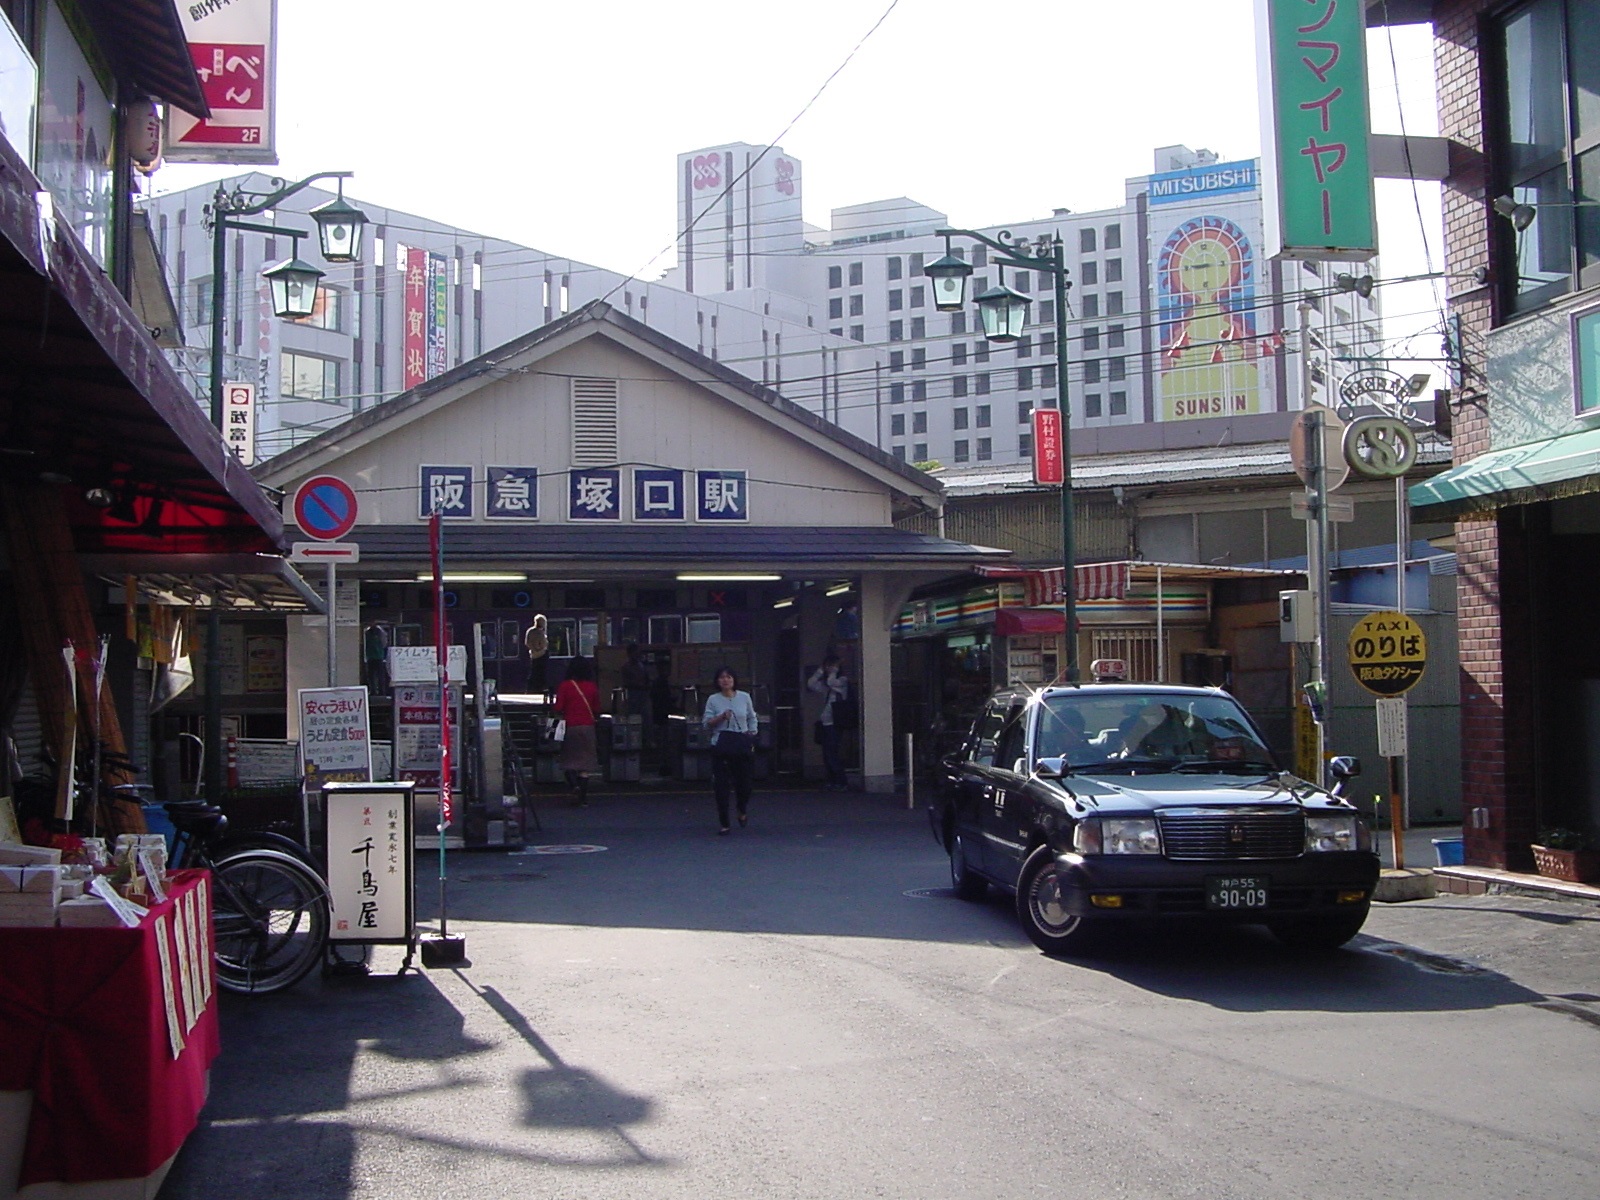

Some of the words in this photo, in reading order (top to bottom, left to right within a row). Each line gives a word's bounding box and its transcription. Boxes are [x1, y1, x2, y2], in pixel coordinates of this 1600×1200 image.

[242, 129, 258, 142] 2F
[1153, 167, 1250, 196] MITSUBISHI
[407, 265, 424, 377] 年賀状
[259, 356, 269, 412] ダイエー
[230, 410, 248, 459] 武富士
[1364, 621, 1410, 632] TAXI
[395, 647, 458, 657] タイムサース
[1354, 635, 1421, 658] のりば
[1360, 666, 1421, 680] 阪急タクシー
[404, 691, 415, 701] 2F
[305, 698, 363, 715] 安くてうまい!
[351, 837, 379, 928] 千鳥屋
[1220, 889, 1266, 907] 90-09
